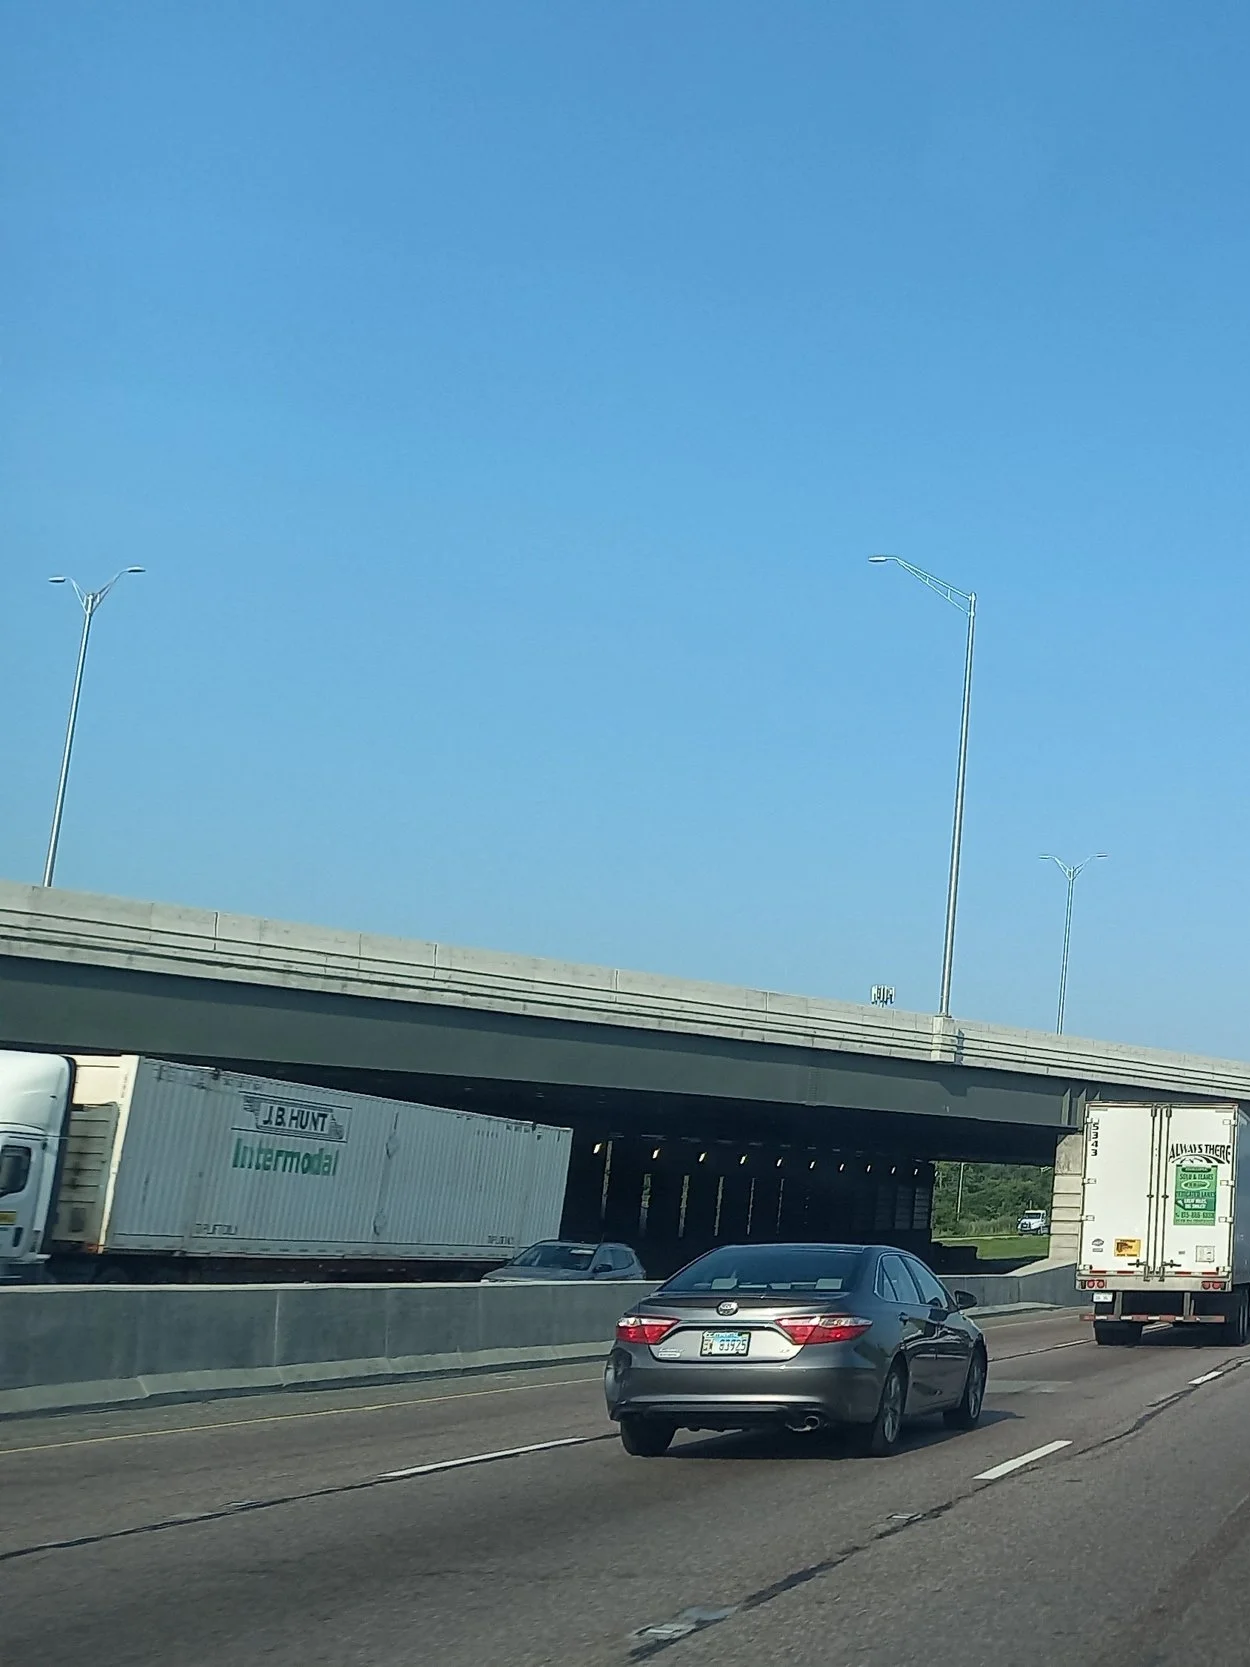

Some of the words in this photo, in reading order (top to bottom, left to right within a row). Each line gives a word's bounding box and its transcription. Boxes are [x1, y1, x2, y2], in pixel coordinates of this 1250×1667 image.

[288, 1108, 328, 1132] HUNT
[232, 1138, 339, 1176] Intermodal
[1169, 1143, 1203, 1162] ALWAYS
[1204, 1144, 1231, 1164] THERE
